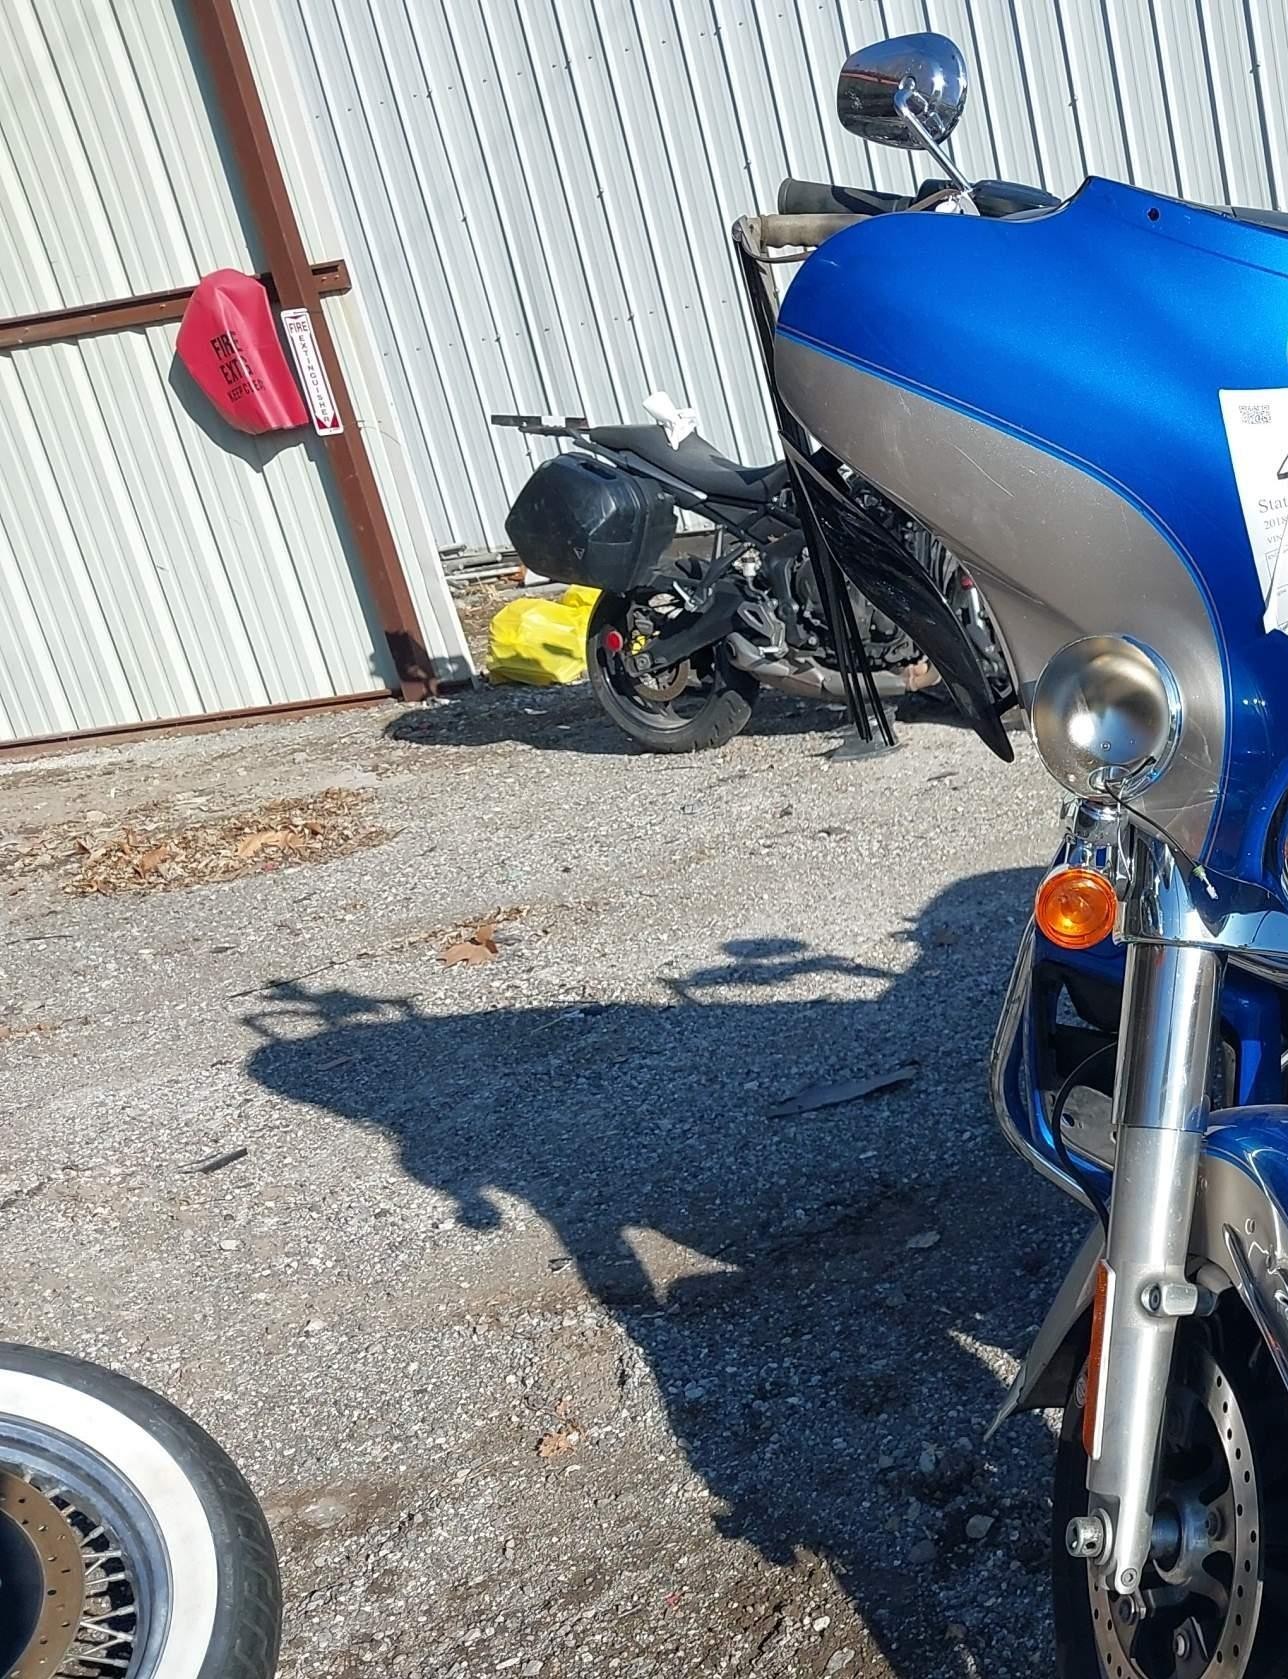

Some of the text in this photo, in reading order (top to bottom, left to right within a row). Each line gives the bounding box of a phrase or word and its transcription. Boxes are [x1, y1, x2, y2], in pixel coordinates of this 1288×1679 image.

[288, 320, 308, 334] FIRE
[210, 330, 243, 361] FIRE
[299, 334, 331, 422] EXTINGUISHER
